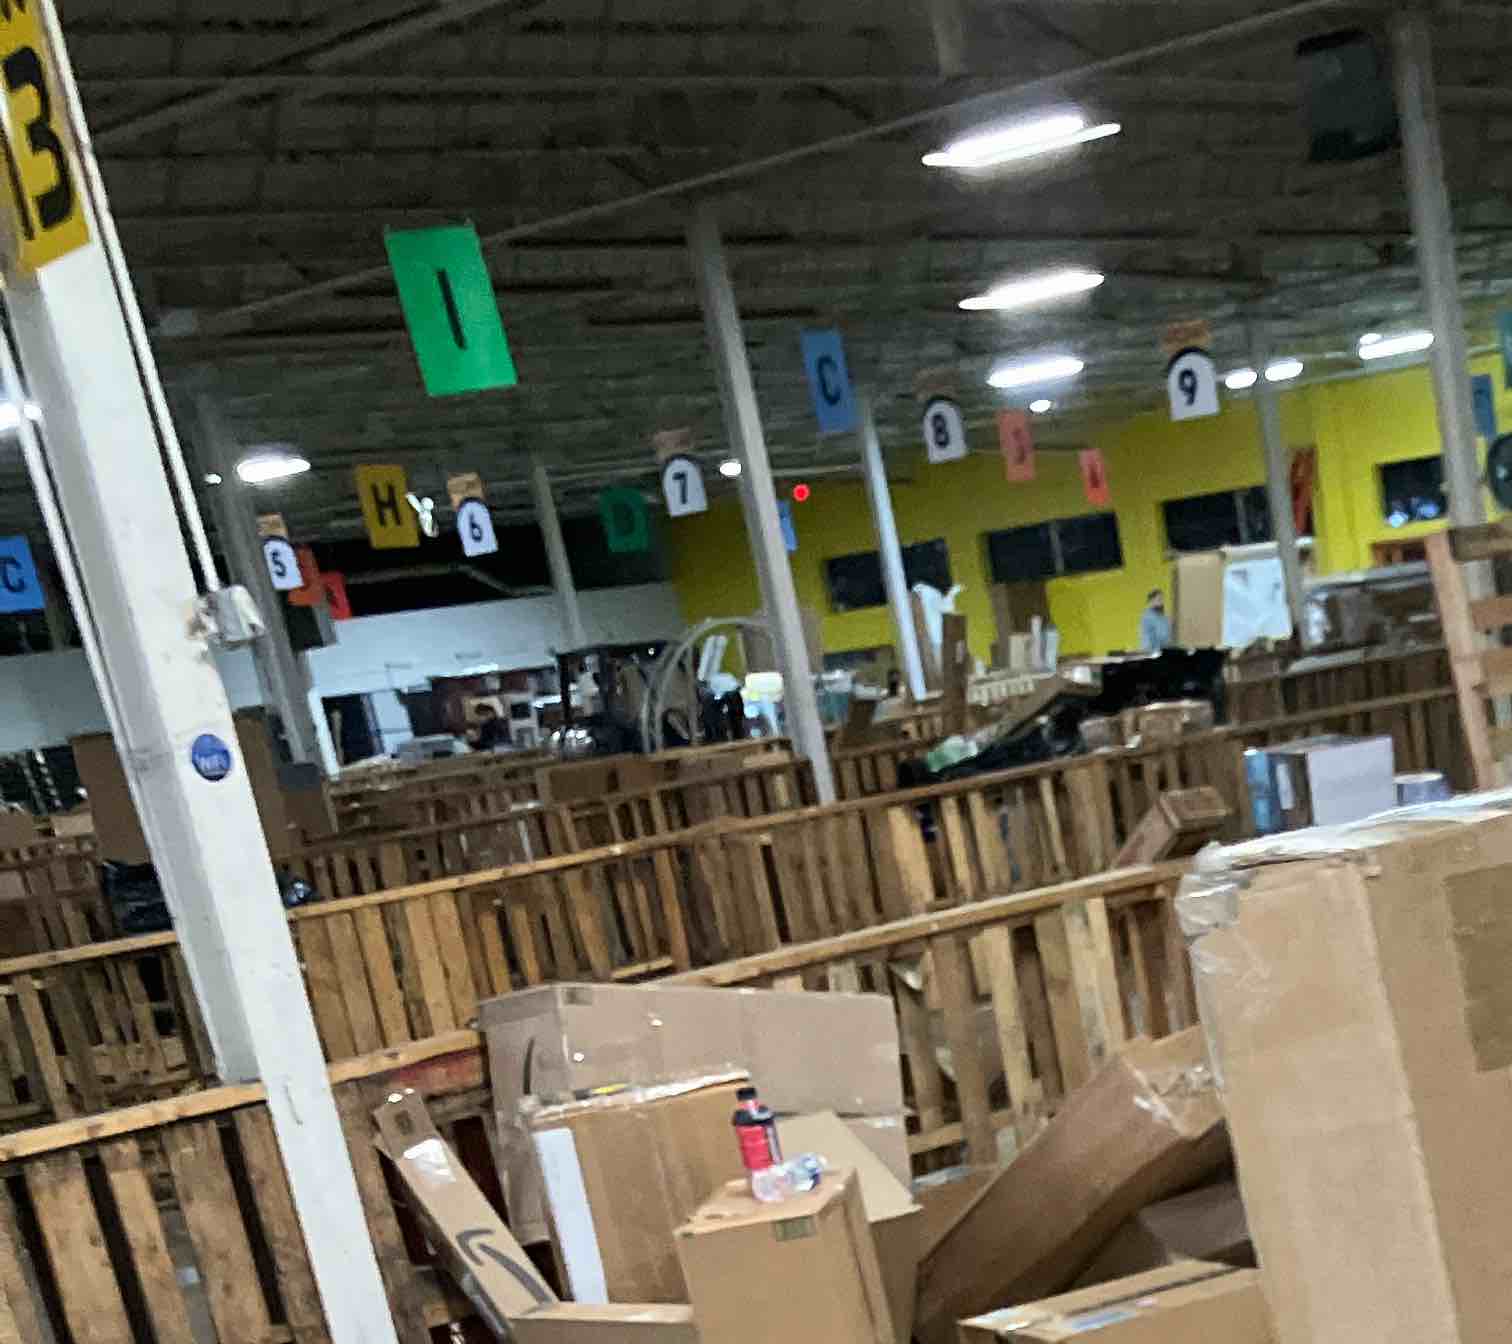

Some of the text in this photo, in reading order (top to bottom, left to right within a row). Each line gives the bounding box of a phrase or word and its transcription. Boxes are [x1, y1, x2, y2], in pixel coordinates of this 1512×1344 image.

[3, 46, 75, 230] 3
[817, 355, 840, 407] C
[1178, 367, 1199, 406] 9
[931, 413, 950, 449] 8
[370, 481, 403, 527] H
[672, 471, 688, 505] 7
[469, 512, 484, 543] 6
[0, 556, 26, 592] C
[270, 550, 287, 578] 5
